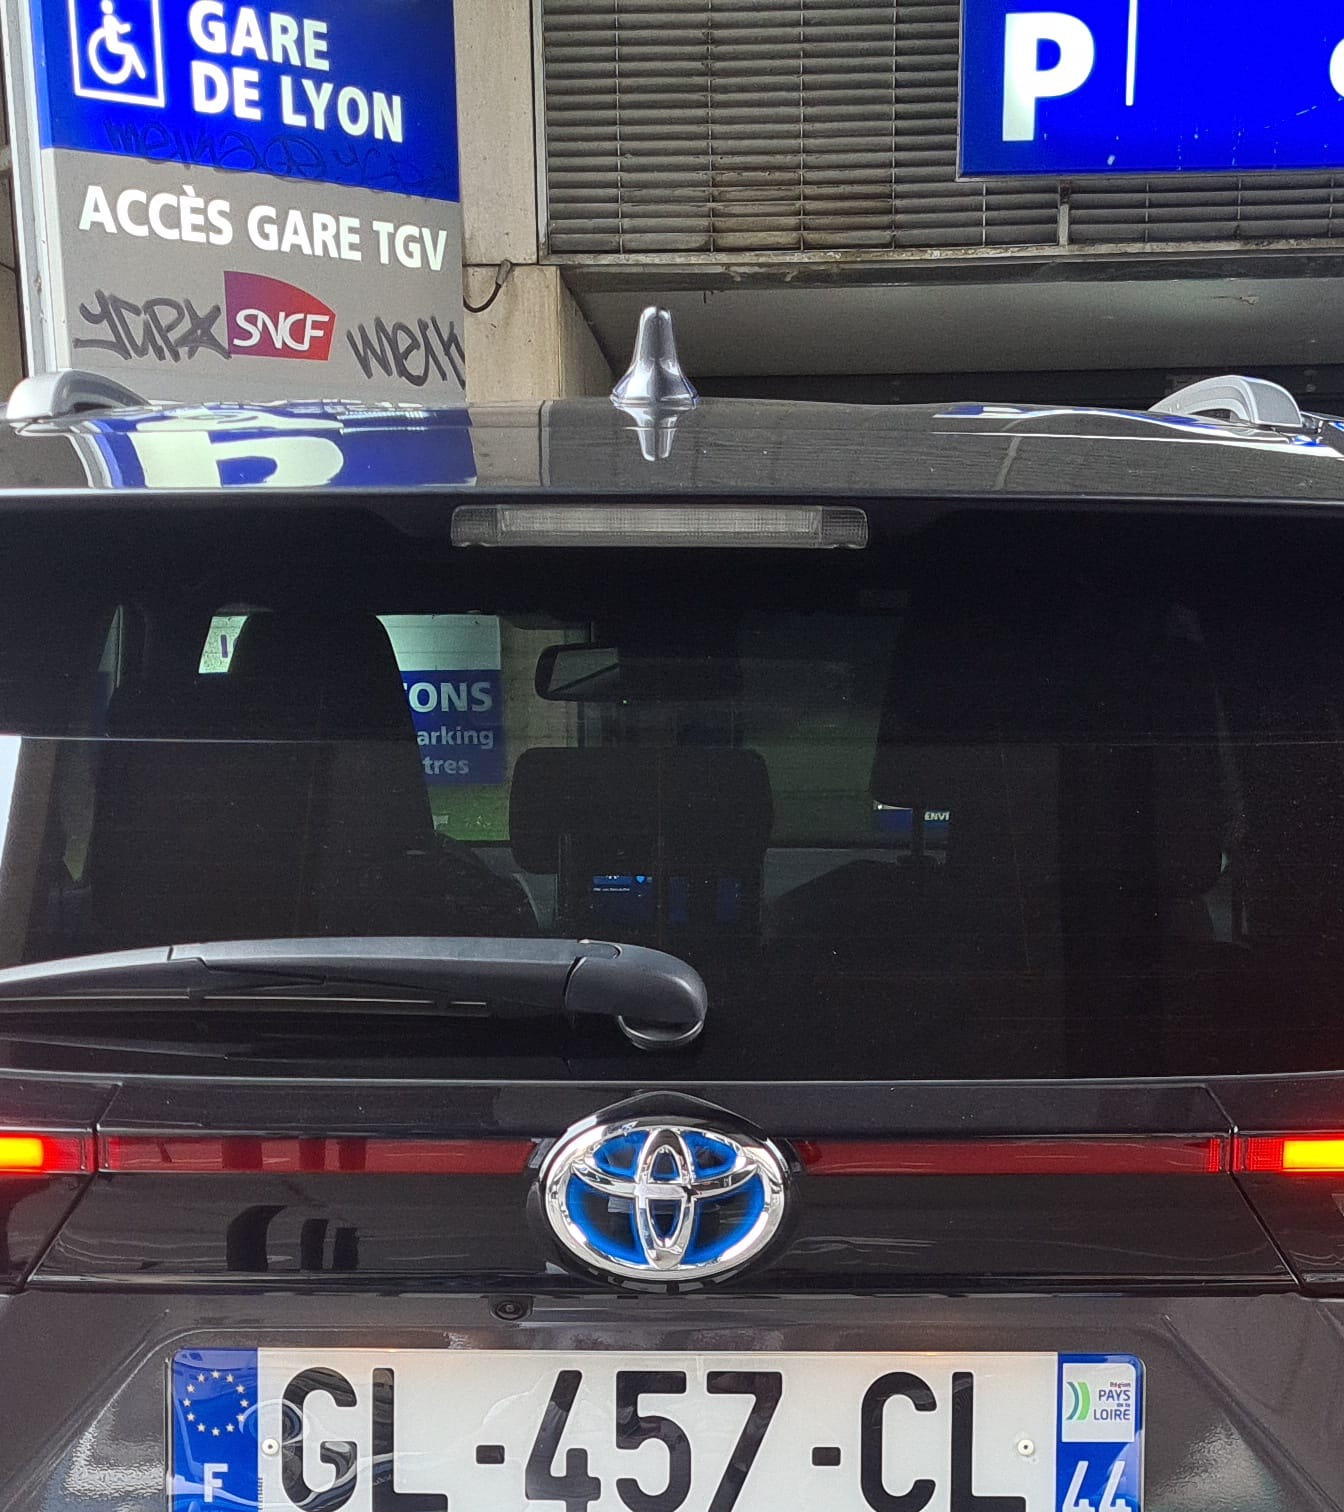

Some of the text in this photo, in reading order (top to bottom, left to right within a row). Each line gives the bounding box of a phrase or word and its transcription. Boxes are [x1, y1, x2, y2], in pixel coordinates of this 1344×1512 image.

[188, 0, 331, 71] GARE
[190, 60, 403, 143] DE LYON
[1002, 12, 1095, 142] P
[79, 184, 447, 271] ACCÈS GARE TGV
[233, 309, 330, 351] SNCF
[1093, 1409, 1131, 1420] LOIRE
[1098, 1389, 1131, 1401] PAYS
[203, 1463, 228, 1502] F
